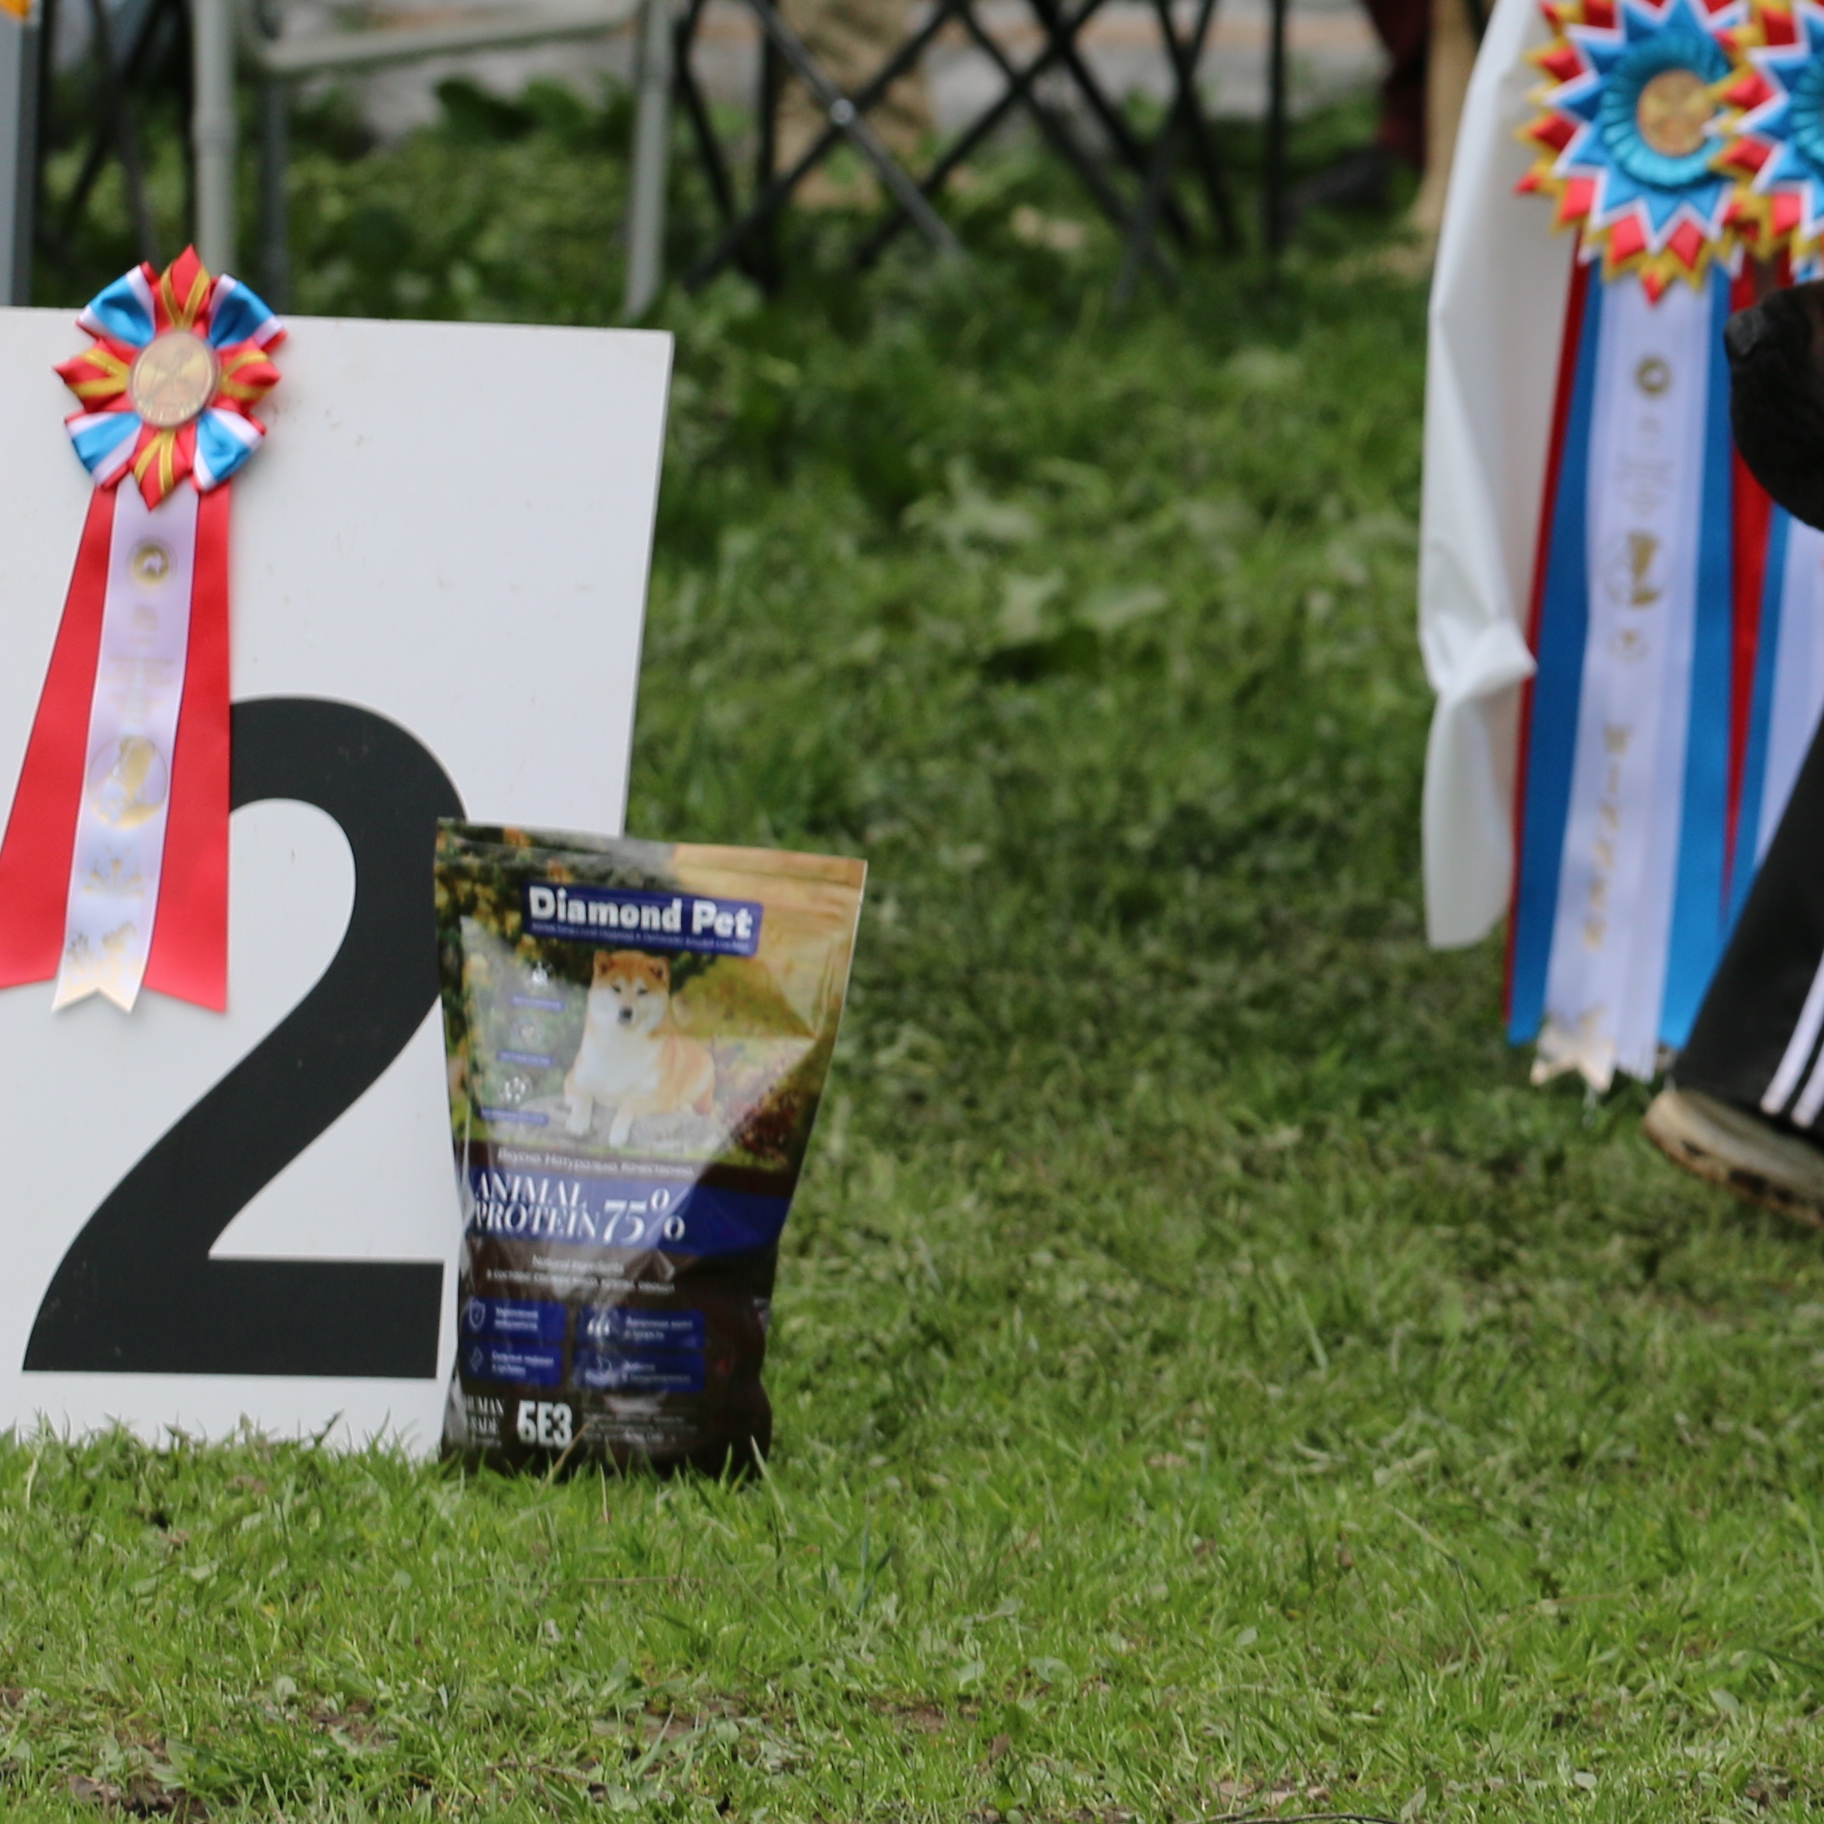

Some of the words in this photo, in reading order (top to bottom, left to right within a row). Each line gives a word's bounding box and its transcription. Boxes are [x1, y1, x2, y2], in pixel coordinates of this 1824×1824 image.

[529, 885, 683, 933] Diamond
[691, 899, 753, 939] Pet
[23, 696, 468, 1379] 2
[475, 1171, 587, 1207] ANIMAL
[475, 1200, 600, 1239] PROTEIN
[602, 1187, 687, 1245] 75%
